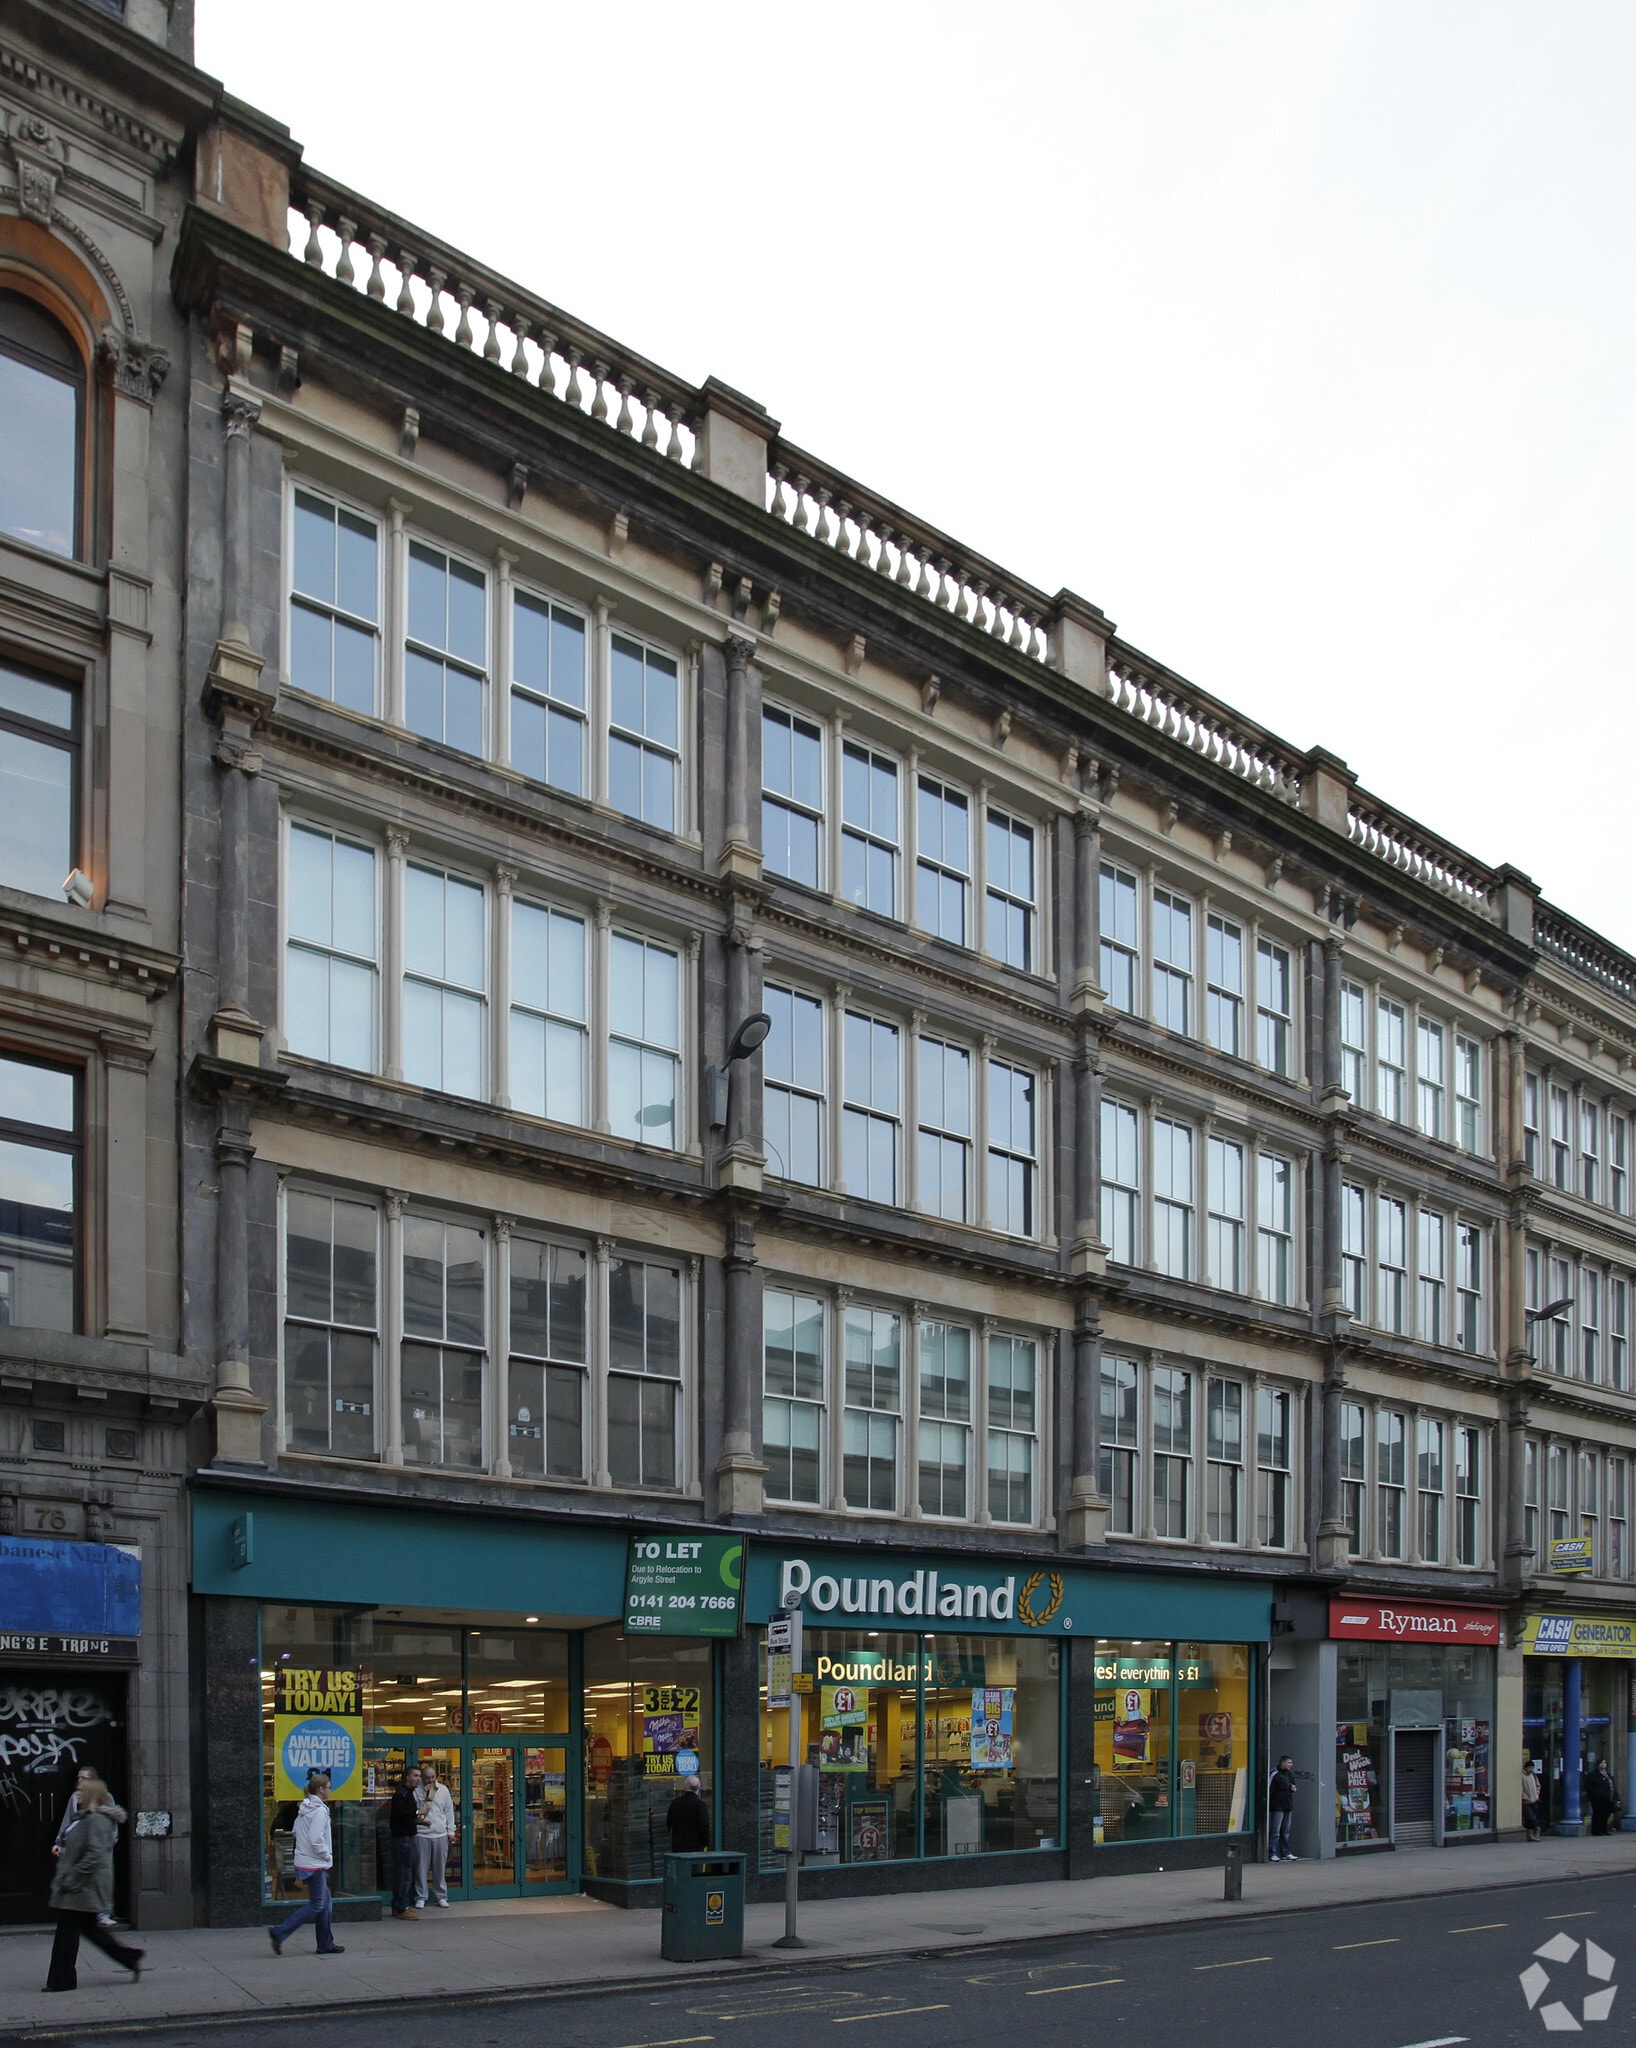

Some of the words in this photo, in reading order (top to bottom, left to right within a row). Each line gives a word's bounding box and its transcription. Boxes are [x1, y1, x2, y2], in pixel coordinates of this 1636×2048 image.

[35, 1508, 66, 1530] 78
[634, 1543, 660, 1559] TO
[666, 1543, 702, 1559] LET
[1555, 1542, 1585, 1552] CASH
[631, 1565, 645, 1573] Due
[647, 1565, 654, 1573] to
[656, 1565, 692, 1574] Relocation
[631, 1575, 653, 1585] Argyle
[655, 1575, 675, 1584] Street
[780, 1559, 1014, 1619] Poundland
[629, 1595, 663, 1608] 0141
[668, 1596, 695, 1609] 204
[700, 1597, 736, 1609] 7666
[628, 1616, 661, 1626] CBRE
[1378, 1609, 1458, 1635] Ryman
[1537, 1618, 1572, 1640] CASH
[1573, 1623, 1632, 1643] GENERATOR
[1535, 1643, 1549, 1652] NOW
[1550, 1644, 1566, 1652] OPEN
[817, 1655, 933, 1682] Poundland
[1120, 1666, 1169, 1683] everythin
[1187, 1666, 1200, 1681] £1
[282, 1669, 322, 1690] TRY
[327, 1671, 355, 1692] US
[282, 1690, 355, 1713] TODAY!
[646, 1689, 659, 1712] 3
[661, 1690, 669, 1710] FOR
[671, 1689, 699, 1713] £2
[838, 1692, 852, 1711] £1
[1126, 1695, 1139, 1711] £1
[986, 1703, 1001, 1714] BIG
[483, 1717, 498, 1732] £1
[988, 1723, 998, 1736] £1
[1210, 1715, 1229, 1736] £1
[289, 1735, 351, 1749] AMAZING
[287, 1750, 350, 1768] VALUE!
[646, 1754, 660, 1764] TRY
[663, 1755, 674, 1764] US
[677, 1756, 696, 1765] WOW
[1343, 1749, 1361, 1763] Deal
[646, 1764, 675, 1773] TODAY!
[679, 1764, 698, 1772] DEAL!
[1348, 1771, 1367, 1779] HALF
[1348, 1778, 1368, 1786] PRICE
[854, 1807, 864, 1815] TOP
[863, 1832, 877, 1848] £1
